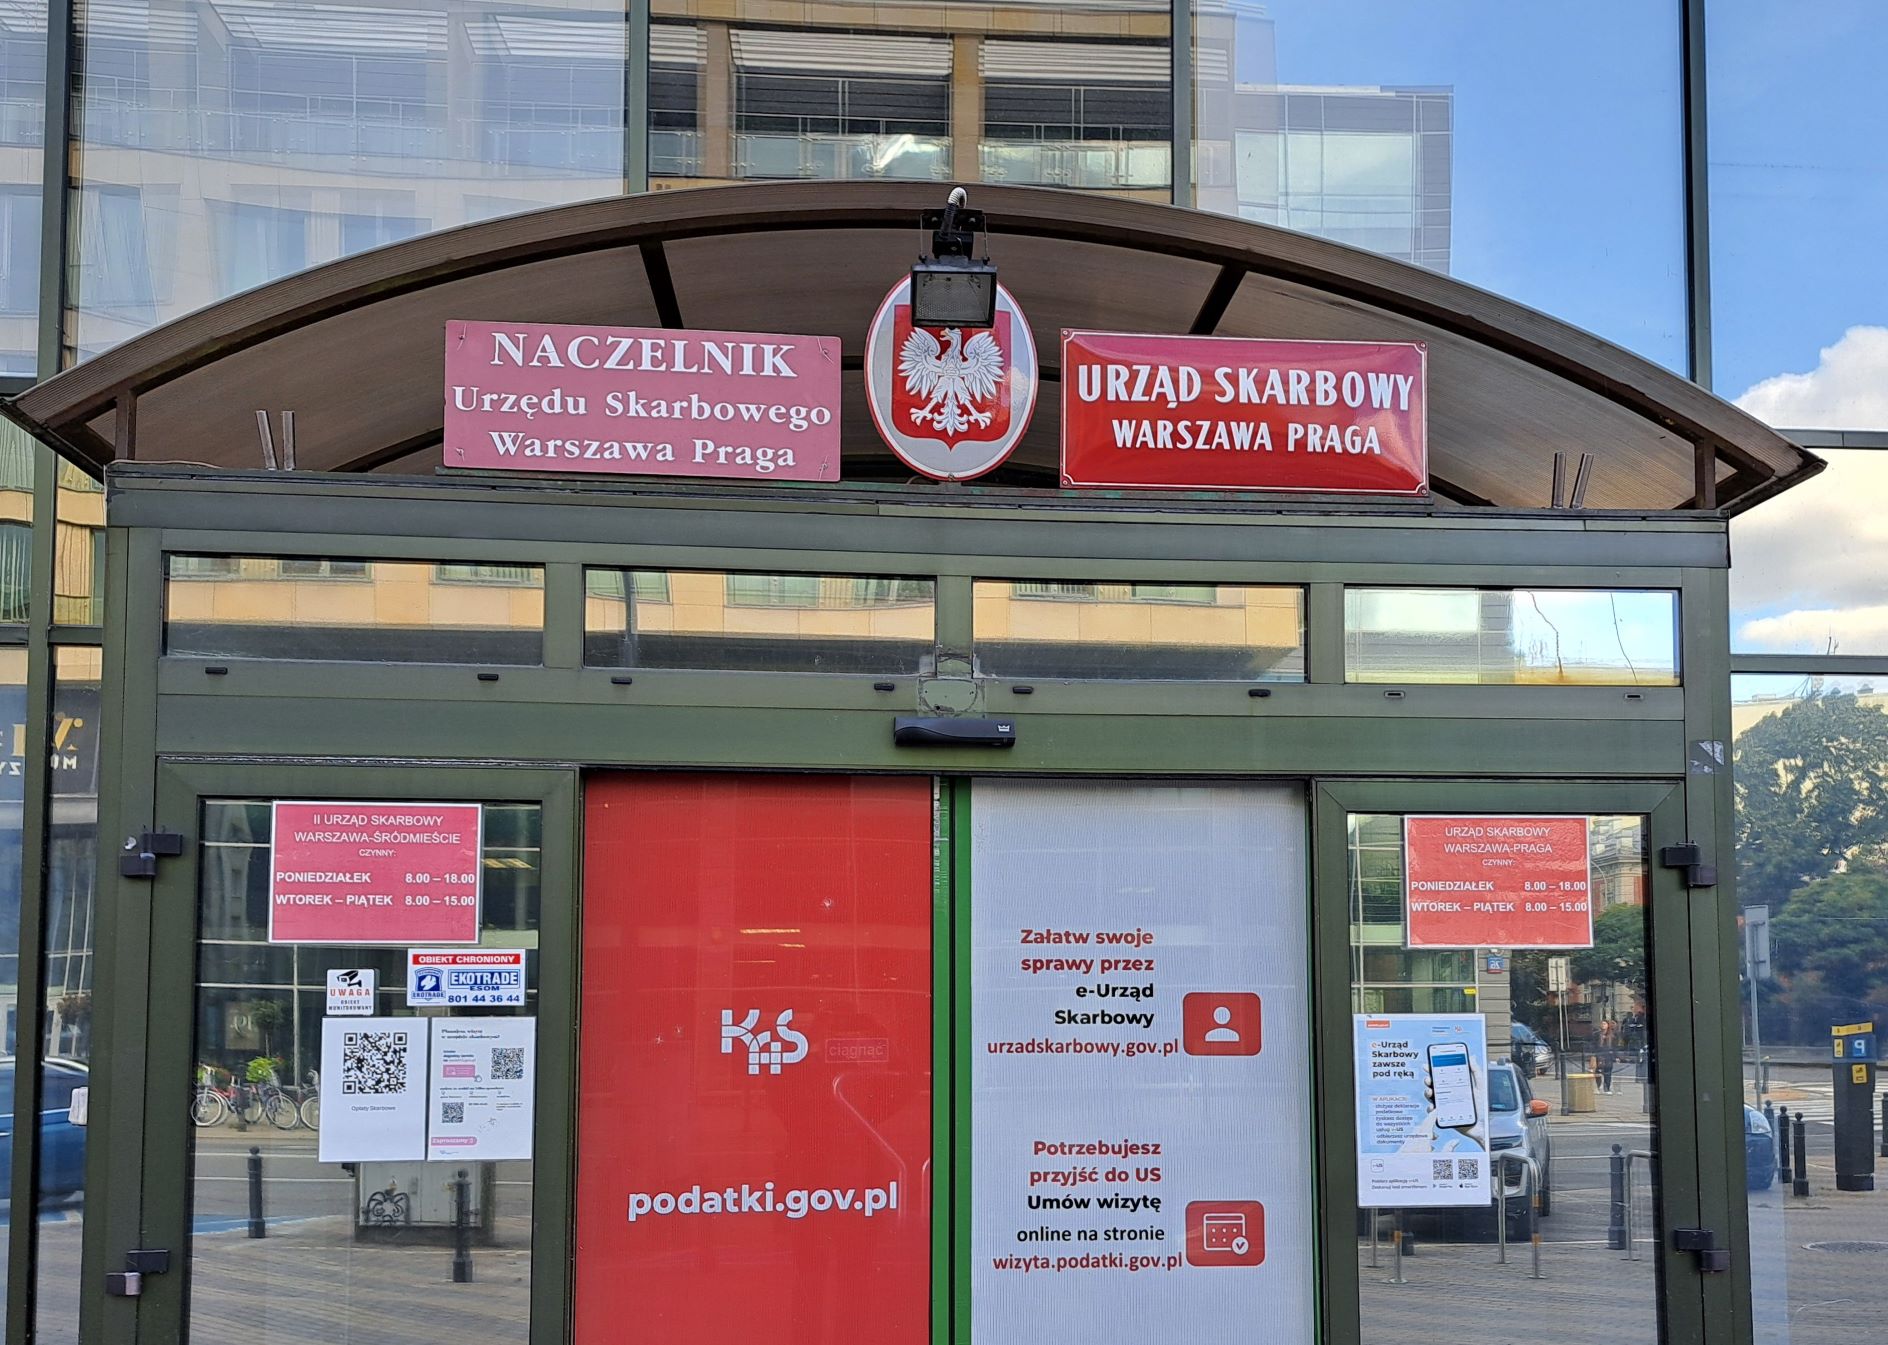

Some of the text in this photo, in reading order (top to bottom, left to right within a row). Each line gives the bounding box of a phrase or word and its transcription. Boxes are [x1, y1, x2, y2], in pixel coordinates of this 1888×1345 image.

[490, 331, 798, 378] NACZELNIK
[1078, 364, 1414, 411] URZĄD SKARBOWY
[452, 386, 832, 432] Urzędu Skarbowego
[1112, 419, 1381, 455] WARSZAWA PRAGA
[489, 431, 796, 473] Warszawa Praga
[313, 814, 443, 828] II URZĄD SKARBOWY
[294, 830, 461, 844] WARSZAWA-ŚRÓDMIEŚCIE
[1445, 827, 1550, 839] URZĄD SKARBOWY
[1444, 843, 1552, 853] WARSZAWA-PRAGA
[276, 872, 371, 883] PONIEDZIAŁEK
[405, 873, 430, 884] 8.00
[444, 873, 475, 884] 18.00
[1411, 881, 1494, 891] PONIEDZIAŁEK
[1524, 881, 1546, 891] 8.00
[1559, 881, 1586, 891] 18.00
[275, 894, 332, 905] WTOREK
[346, 895, 393, 907] PIĄTEK
[405, 896, 430, 906] 8.00
[444, 895, 475, 906] 15.00
[1411, 902, 1461, 912] WTOREK
[1473, 902, 1515, 914] PIĄTEK
[1525, 902, 1547, 912] 8.00
[1560, 902, 1587, 912] 15.00
[1020, 928, 1154, 947] Załatw swoje
[418, 955, 515, 964] OBIEKT CHRONIONY
[1021, 958, 1154, 974] sprawy przez
[450, 972, 518, 985] EKOTRADE
[448, 995, 468, 1003] 801
[472, 995, 486, 1003] 44
[489, 995, 503, 1003] 36
[1075, 983, 1154, 1002] e-Urząd
[1054, 1009, 1154, 1028] Skarbowy
[987, 1038, 1179, 1057] urzadskarbowy.gov.pl
[1372, 1041, 1408, 1051] e-Urząd
[1372, 1051, 1419, 1060] Skarbowy
[1373, 1070, 1415, 1079] pod ręką
[1033, 1138, 1162, 1159] Potrzebujesz
[1030, 1166, 1162, 1186] przyjść do US
[628, 1181, 898, 1222] podatki.gov.pl
[1027, 1192, 1162, 1212] Umów wizytę
[1017, 1225, 1165, 1242] online na stronie
[993, 1252, 1183, 1272] wizyta.podatki.gov.pl
